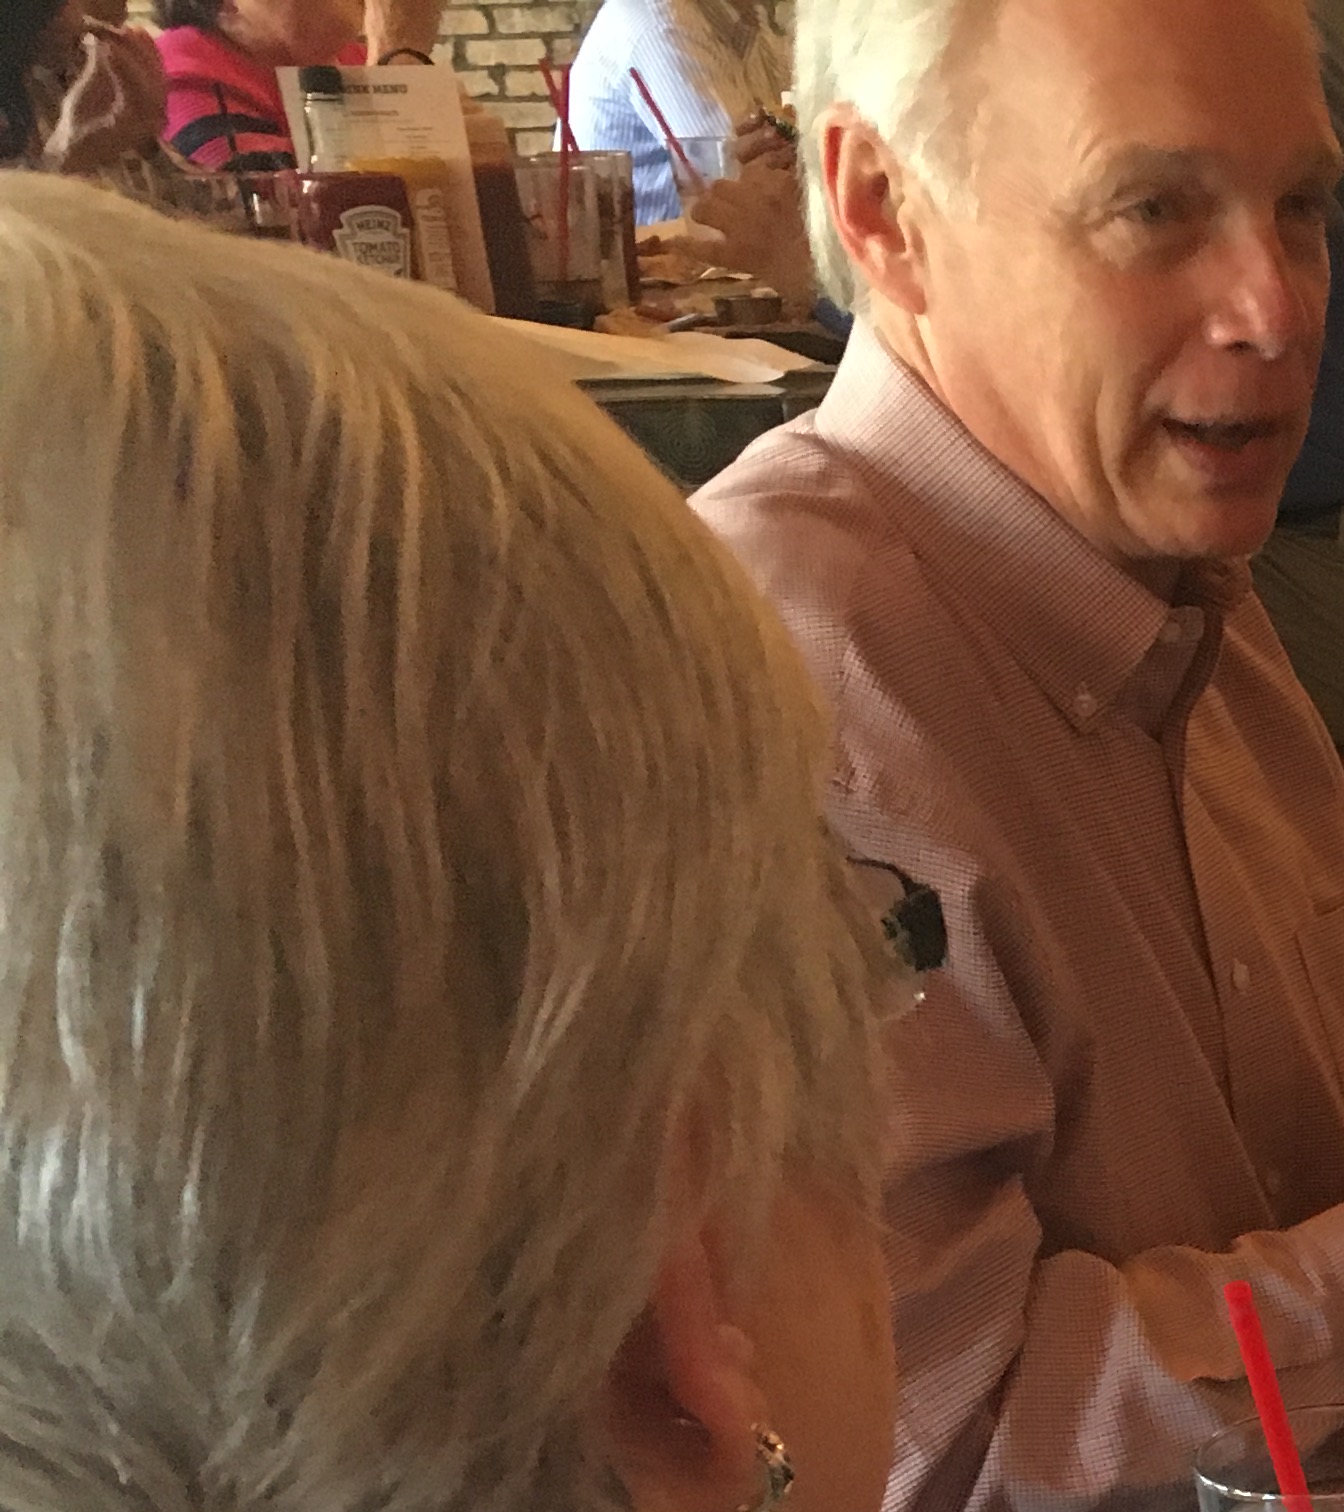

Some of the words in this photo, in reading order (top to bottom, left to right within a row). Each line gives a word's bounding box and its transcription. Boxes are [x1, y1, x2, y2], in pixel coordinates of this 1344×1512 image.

[373, 84, 408, 94] MENU
[356, 218, 392, 232] HEINZ
[352, 241, 401, 254] TOMATO
